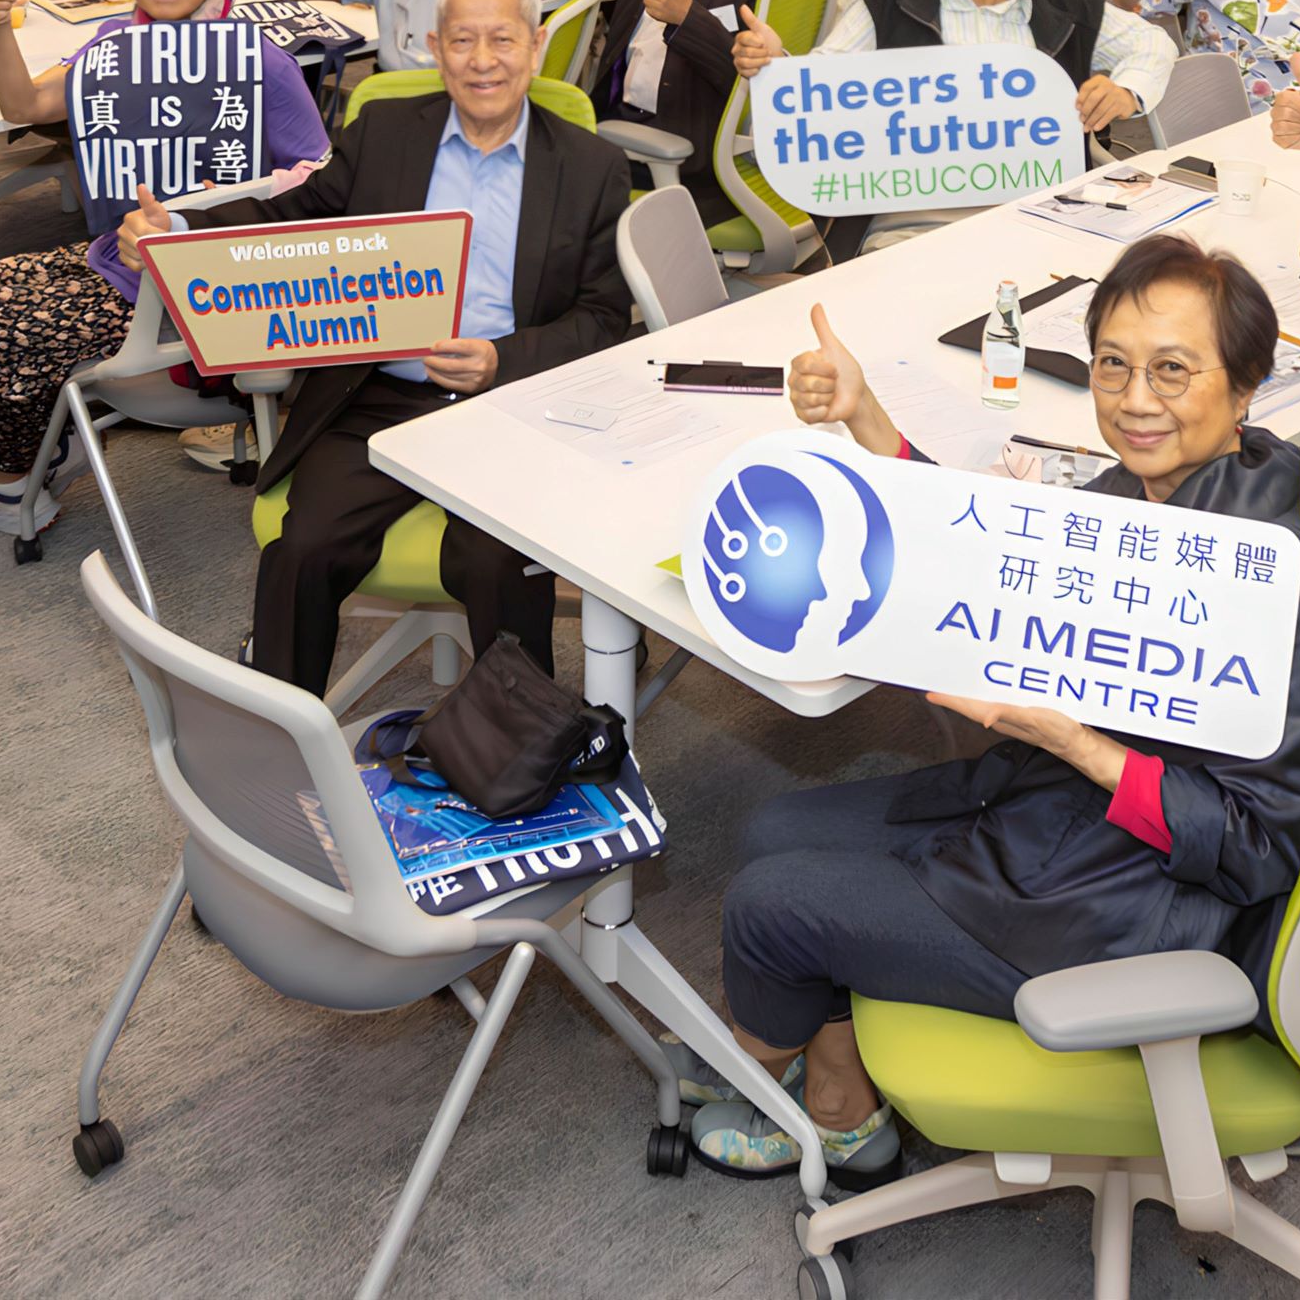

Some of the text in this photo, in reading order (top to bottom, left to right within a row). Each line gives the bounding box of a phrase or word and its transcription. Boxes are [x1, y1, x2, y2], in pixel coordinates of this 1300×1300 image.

[124, 23, 263, 85] TRUTH
[150, 96, 183, 127] IS
[772, 63, 1037, 115] cheers to
[774, 111, 1062, 164] the future
[78, 136, 207, 201] VIRTUE
[811, 158, 1063, 203] #HKBUCOMM
[229, 232, 389, 262] Welcome Back
[187, 260, 445, 316] Communication
[266, 304, 380, 350] Alumni
[950, 493, 1278, 586] 人工智能媒體
[999, 554, 1209, 627] 研究中心
[935, 600, 1262, 697] AI MEDIA
[983, 660, 1201, 726] CENTRE
